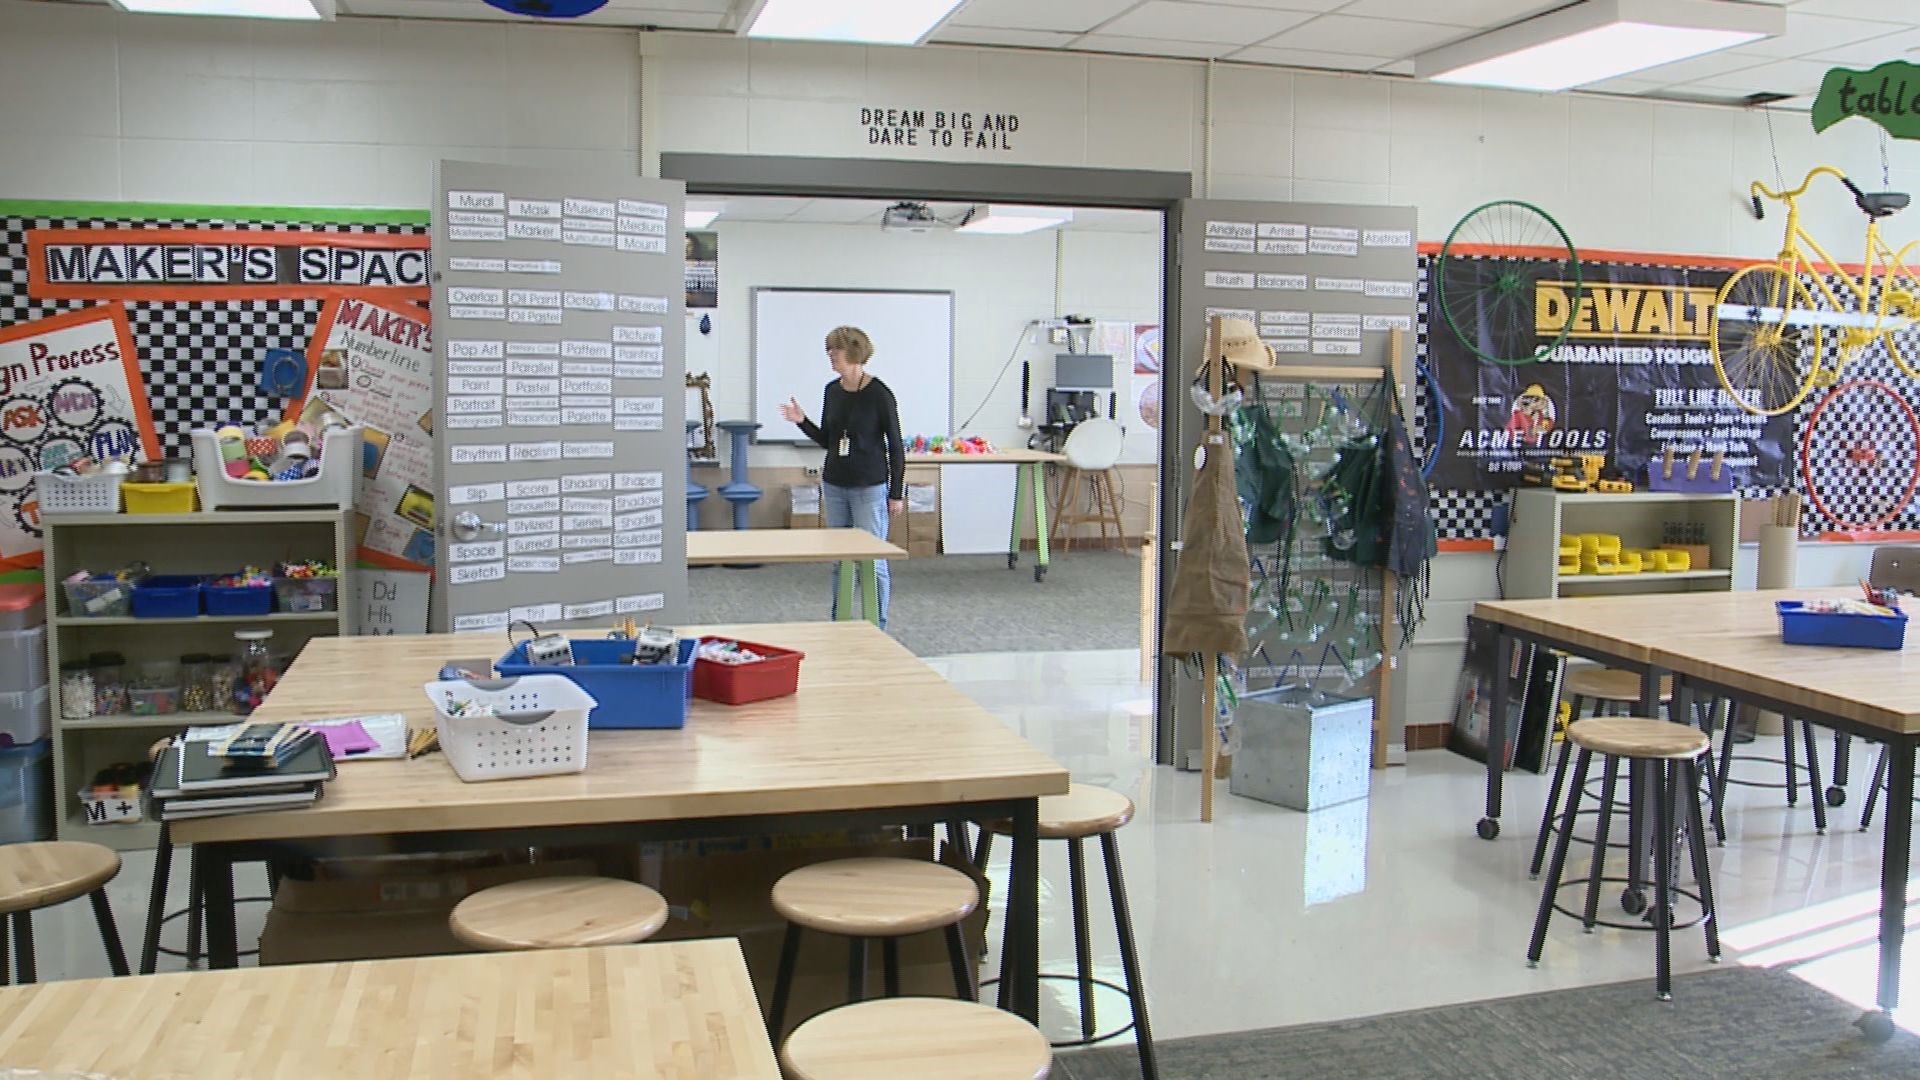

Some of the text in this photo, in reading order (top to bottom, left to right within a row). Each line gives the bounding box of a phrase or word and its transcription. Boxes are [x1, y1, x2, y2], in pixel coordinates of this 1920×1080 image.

[860, 108, 1018, 133] DREAM BIG AND
[869, 128, 1011, 150] DARE TO FAIL
[459, 195, 494, 208] Mural
[520, 203, 549, 215] Mask
[565, 201, 613, 216] Museum
[514, 223, 553, 236] Marker
[619, 218, 664, 233] Medium
[1209, 224, 1252, 239] Analyze
[1270, 226, 1295, 236] Artist
[624, 237, 659, 250] Mount
[1365, 233, 1408, 243] Abstract
[51, 247, 431, 284] MAKER'S SPAC
[1215, 274, 1245, 286] Brush
[1259, 276, 1304, 287] Balance
[453, 290, 498, 304] Overlap
[510, 292, 558, 305] Oil Paint
[511, 310, 559, 322] Oil Pastel
[1313, 325, 1357, 337] Contrast
[340, 331, 420, 372] Number line
[453, 343, 498, 358] Pop Art
[567, 343, 606, 355] Pattern
[1325, 343, 1348, 354] Clay
[1534, 345, 1653, 363] GUARANTEED
[29, 342, 119, 376] Process
[619, 350, 658, 361] Painting
[511, 361, 553, 373] Parallel
[462, 379, 489, 391] Paint
[516, 382, 550, 393] Pastel
[564, 379, 608, 392] Portfolio
[1655, 389, 1761, 405] FULL LINE DELER
[453, 399, 495, 410] Portrait
[3, 404, 44, 431] ASK
[567, 411, 606, 422] Palette
[1645, 413, 1767, 424] Cordless Tools Saws Lasers
[1459, 430, 1607, 449] ACME TOOLS
[1650, 428, 1761, 440] Compressors Tool Storage
[95, 429, 133, 462] PLAN
[513, 446, 557, 458] Realism
[456, 449, 502, 463] Rhythm
[563, 478, 609, 490] Shading
[621, 475, 656, 488] Shape
[466, 488, 487, 503] Slip
[516, 484, 549, 496] Score
[514, 519, 553, 531] Stylized
[573, 518, 603, 528] Series
[514, 538, 553, 551] Surreal
[615, 533, 660, 545] Sculpture
[456, 546, 496, 560] Space
[457, 567, 497, 580] Sketch
[372, 581, 396, 601] Dd
[367, 604, 391, 624] Hh
[526, 609, 544, 619] Tint
[84, 800, 106, 821] M
